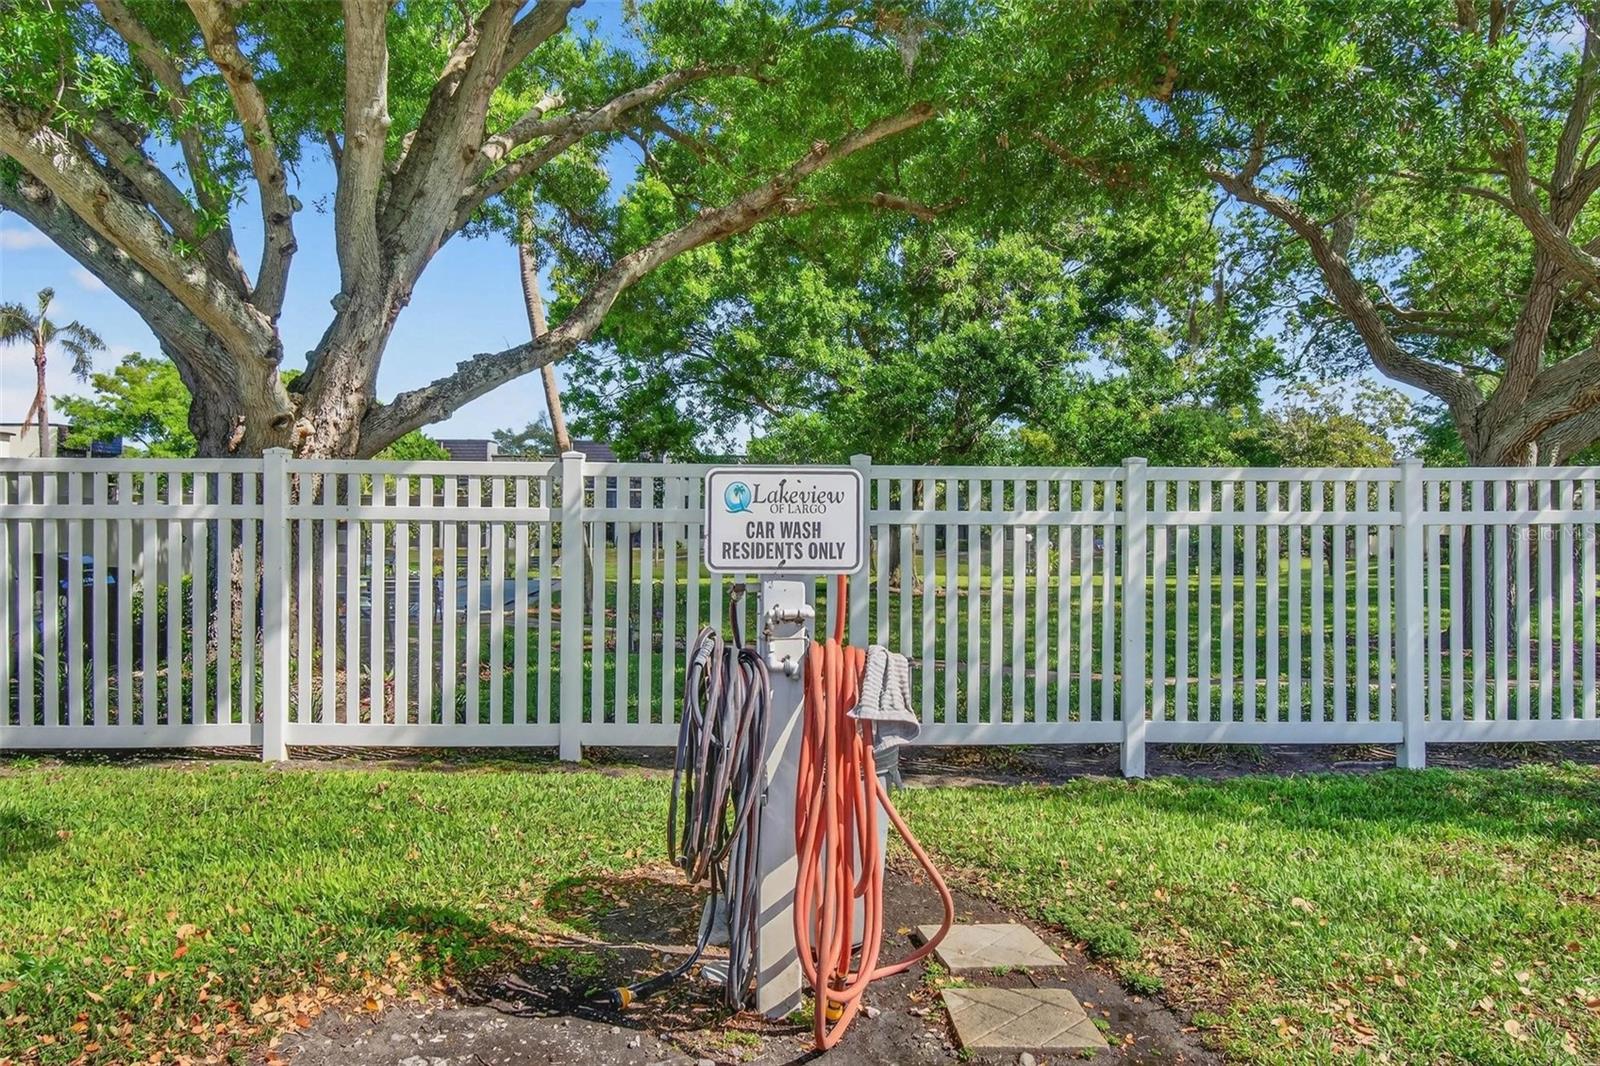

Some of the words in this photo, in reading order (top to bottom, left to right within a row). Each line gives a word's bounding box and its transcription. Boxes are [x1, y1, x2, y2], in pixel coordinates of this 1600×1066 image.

[753, 483, 844, 504] Lakeview
[770, 504, 784, 513] OF
[788, 504, 826, 514] LARGO
[746, 521, 774, 538] CAR
[780, 521, 821, 538] WASH
[722, 542, 803, 559] RESIDENTS
[808, 542, 845, 559] ONLY
